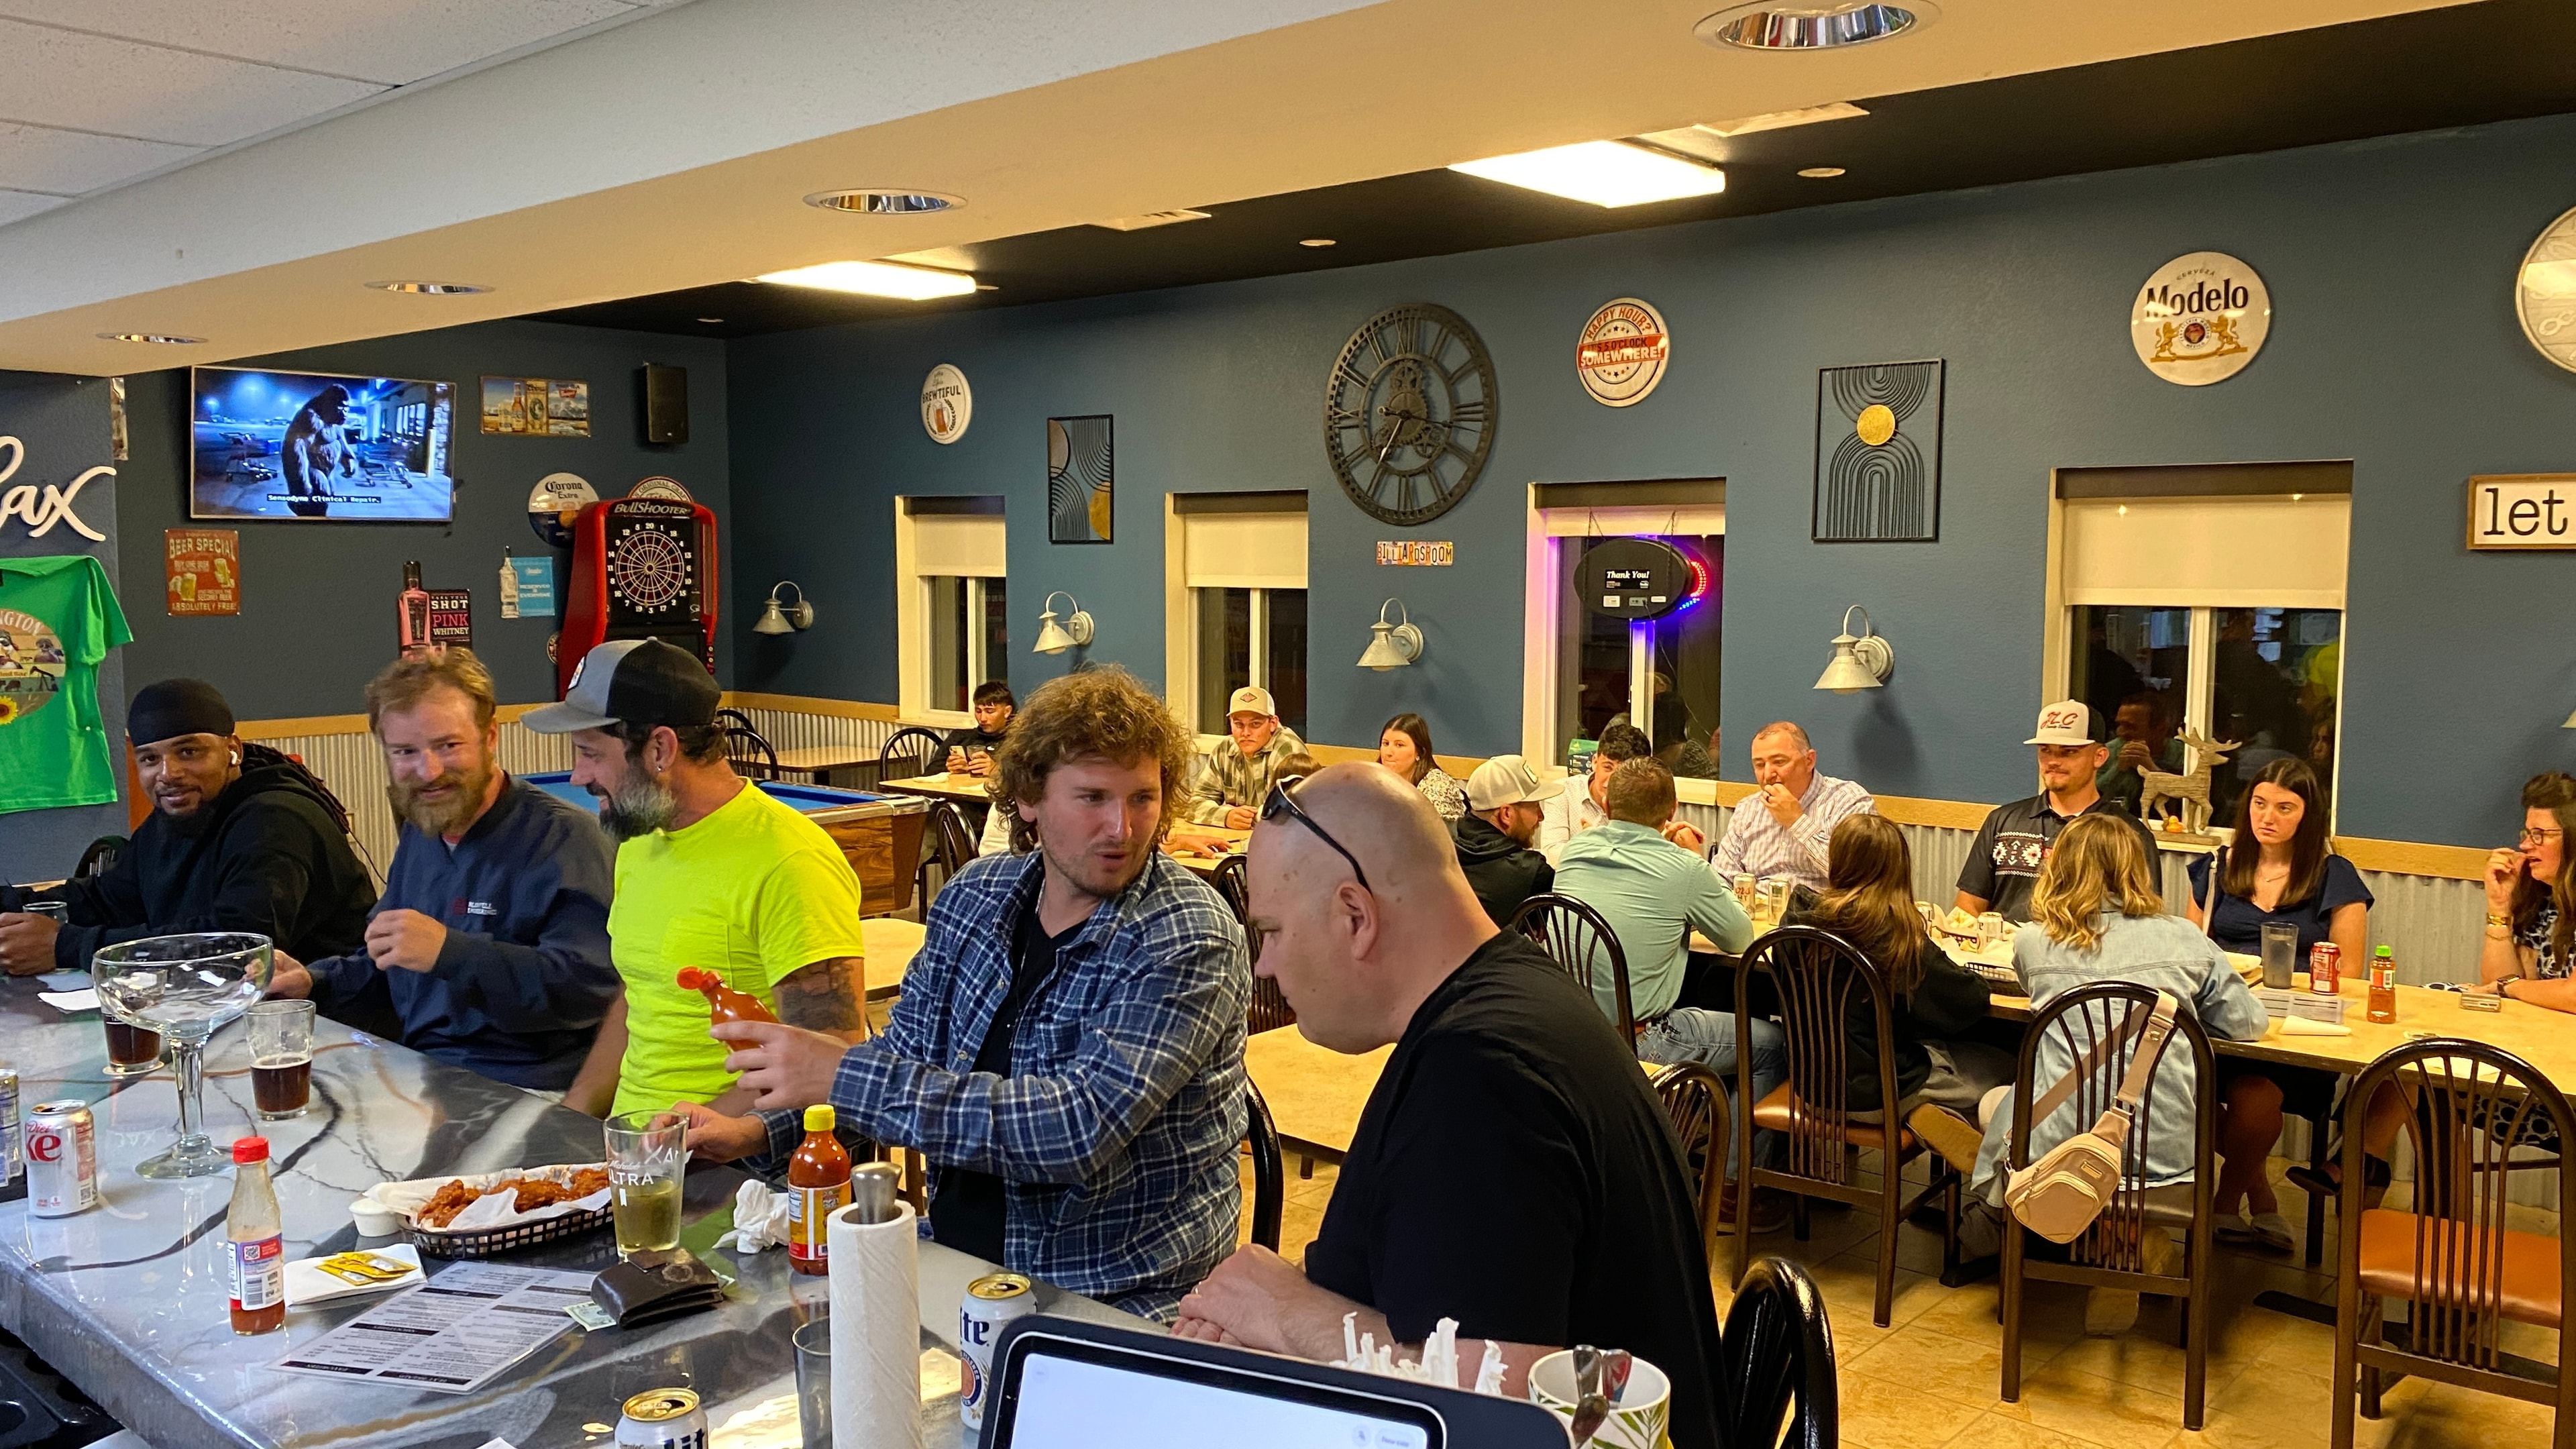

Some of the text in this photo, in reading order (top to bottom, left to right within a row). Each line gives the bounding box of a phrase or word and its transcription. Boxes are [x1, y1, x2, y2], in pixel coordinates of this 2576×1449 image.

[2177, 268, 2216, 280] CERVEZA
[2147, 278, 2249, 317] Modelo
[1587, 307, 1652, 339] HAPPY HOUR?
[1605, 342, 1609, 350] 5
[1611, 337, 1648, 350] O'CLOCK
[1581, 346, 1662, 367] SOMEWHERE!
[922, 385, 961, 403] BREWTIFUL
[545, 482, 583, 494] Corona
[639, 480, 670, 493] ORIGINAL
[672, 485, 688, 499] CRAF
[557, 491, 578, 499] Extra
[2483, 488, 2568, 536] let
[170, 538, 236, 562] BEER SPECIAL
[1606, 571, 1650, 579] Thank You!
[172, 602, 216, 611] ABSOLUTELY
[431, 600, 469, 609] SHOT
[0, 610, 44, 637] GTON
[432, 614, 469, 627] PINK
[433, 627, 469, 636] WHITNEY
[27, 1120, 51, 1133] Diet
